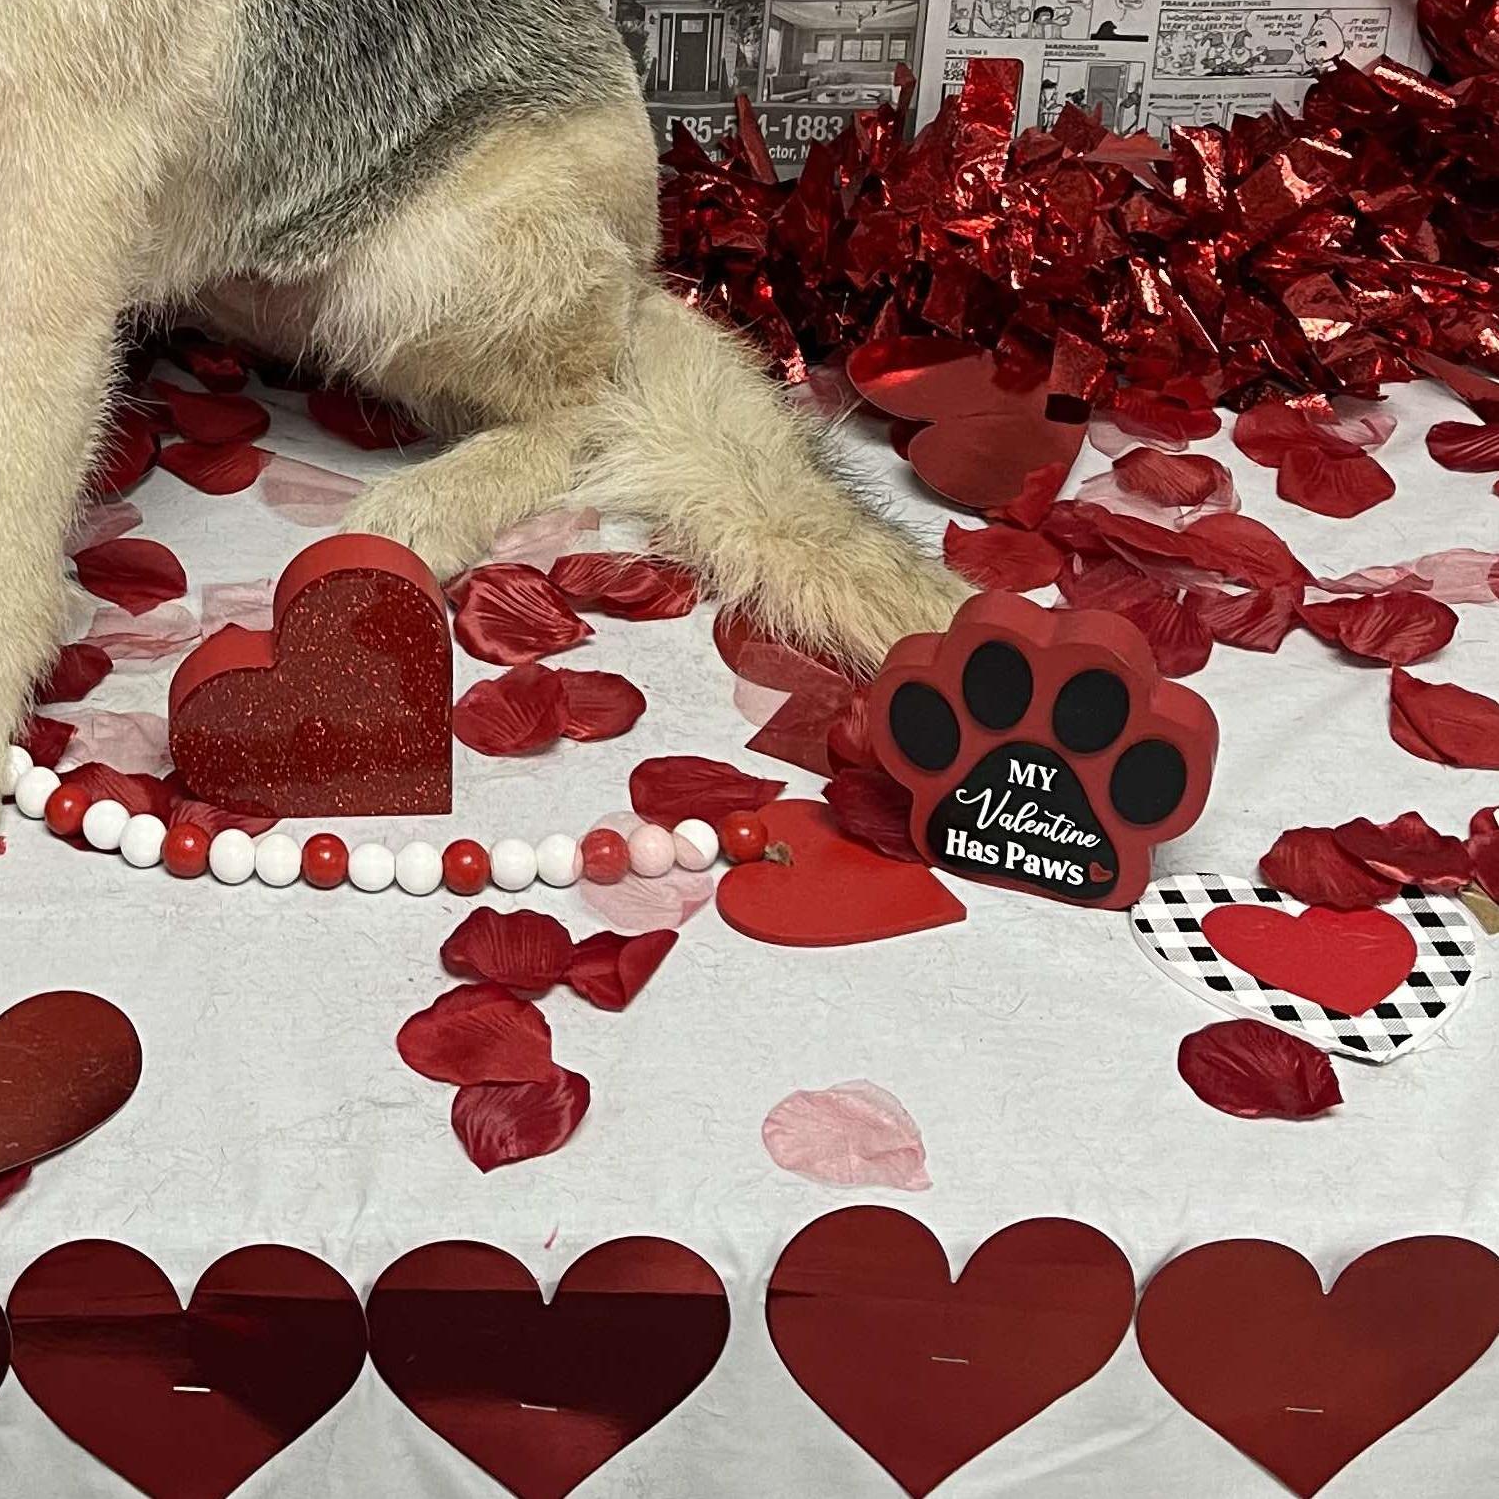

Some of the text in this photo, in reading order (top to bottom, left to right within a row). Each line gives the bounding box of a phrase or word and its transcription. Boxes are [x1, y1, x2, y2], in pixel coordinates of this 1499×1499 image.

[1007, 759, 1059, 791] MY
[955, 788, 1102, 849] Valentine
[945, 829, 1085, 887] Has Paws
